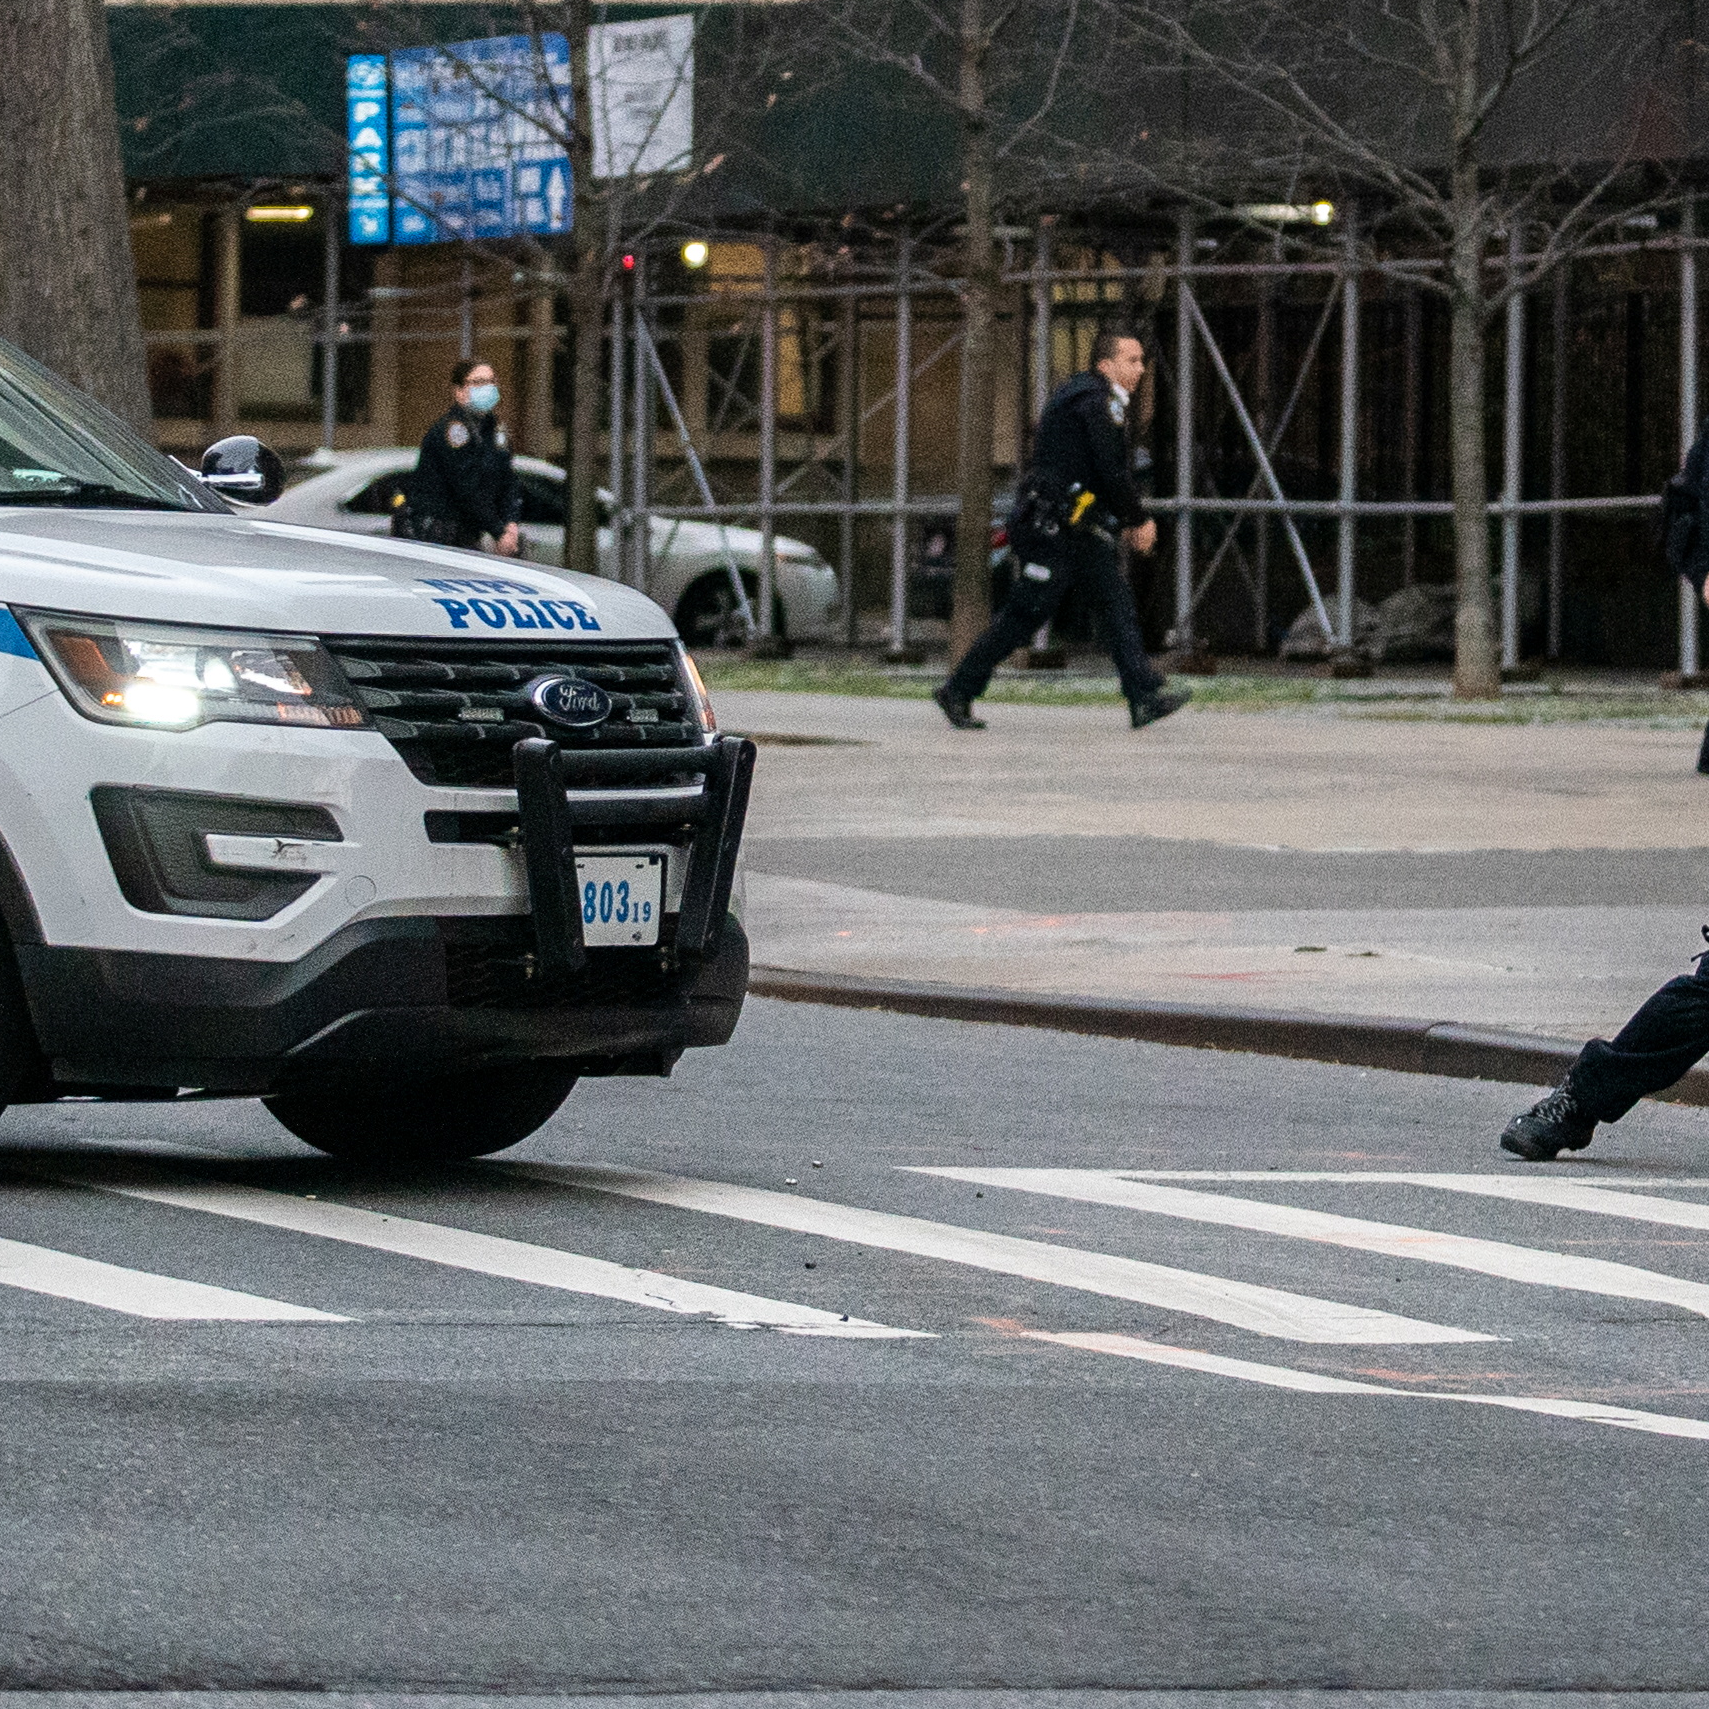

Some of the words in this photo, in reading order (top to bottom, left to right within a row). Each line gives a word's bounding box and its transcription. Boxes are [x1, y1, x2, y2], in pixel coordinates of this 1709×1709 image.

[416, 578, 539, 595] NYPD
[433, 598, 602, 631] POLICE
[558, 685, 602, 713] Ford
